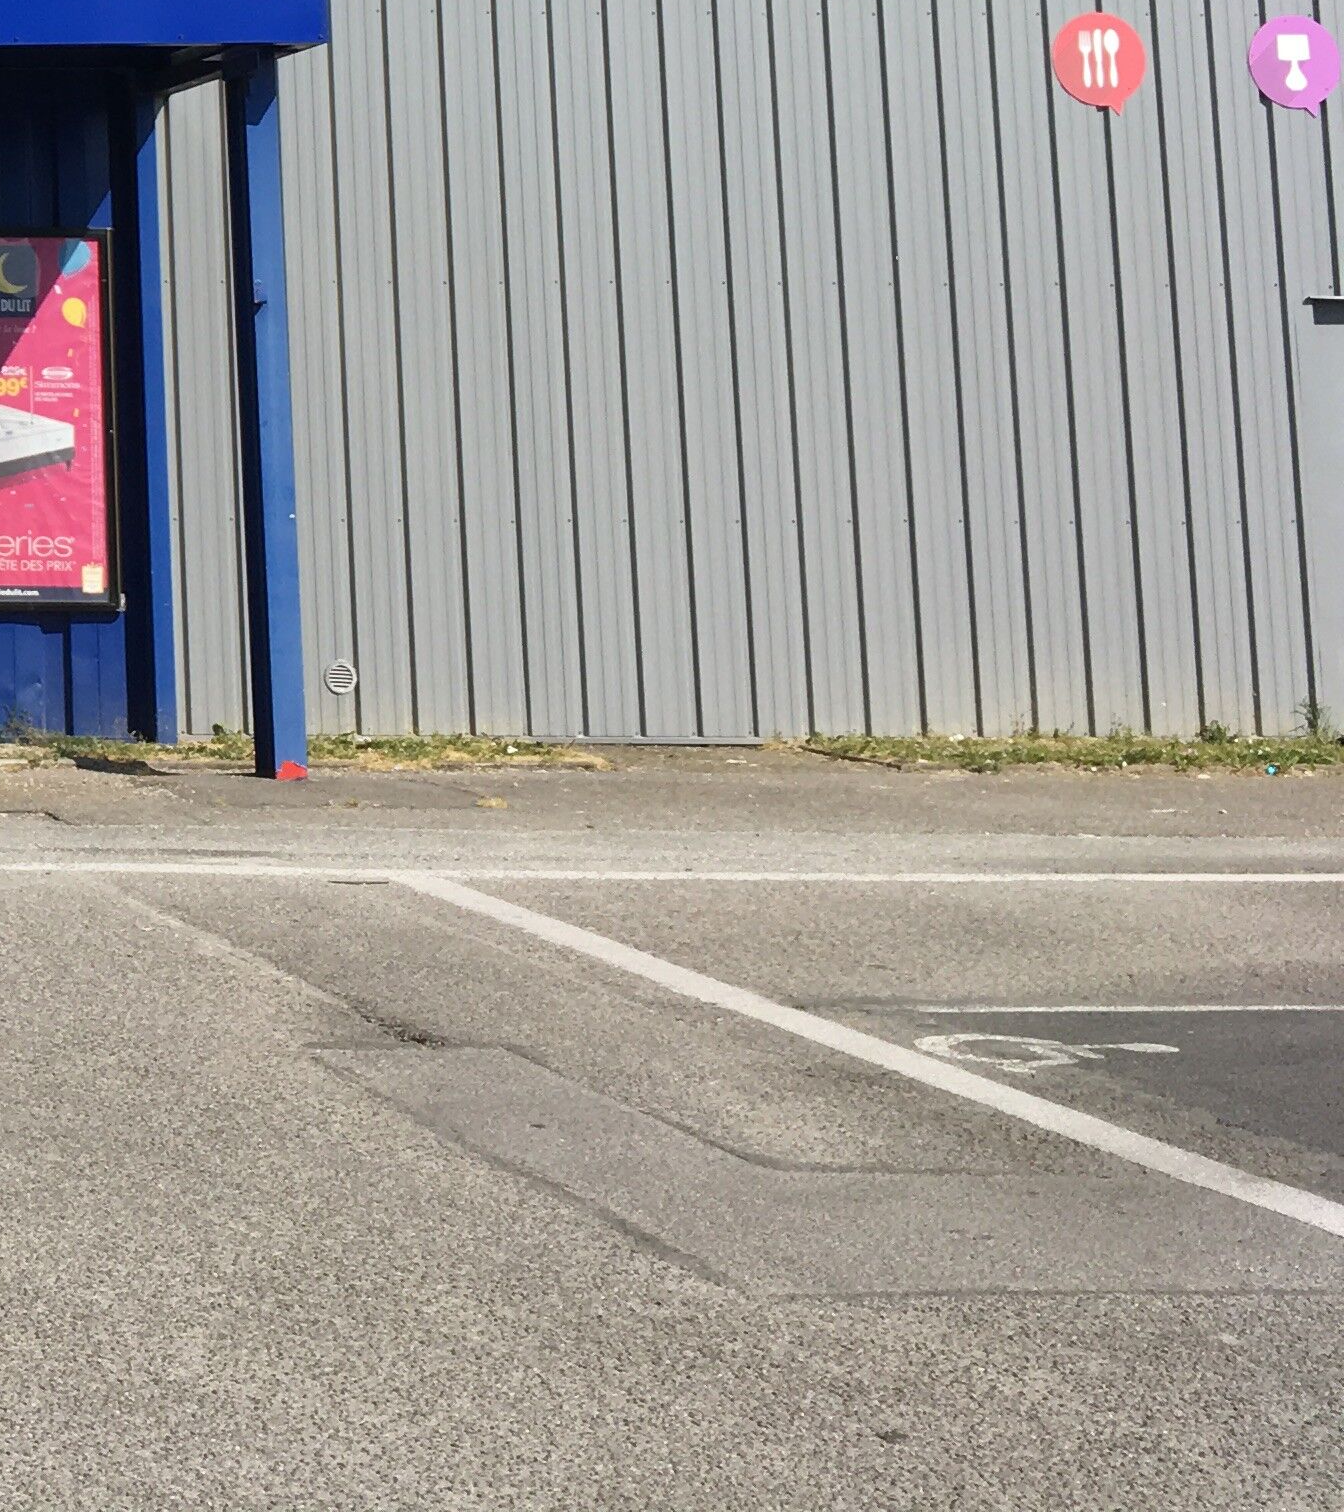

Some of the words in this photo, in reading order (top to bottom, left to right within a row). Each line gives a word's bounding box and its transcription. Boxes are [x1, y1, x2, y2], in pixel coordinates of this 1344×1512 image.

[1, 299, 15, 312] DU
[17, 299, 32, 313] LIT
[20, 560, 43, 572] DES
